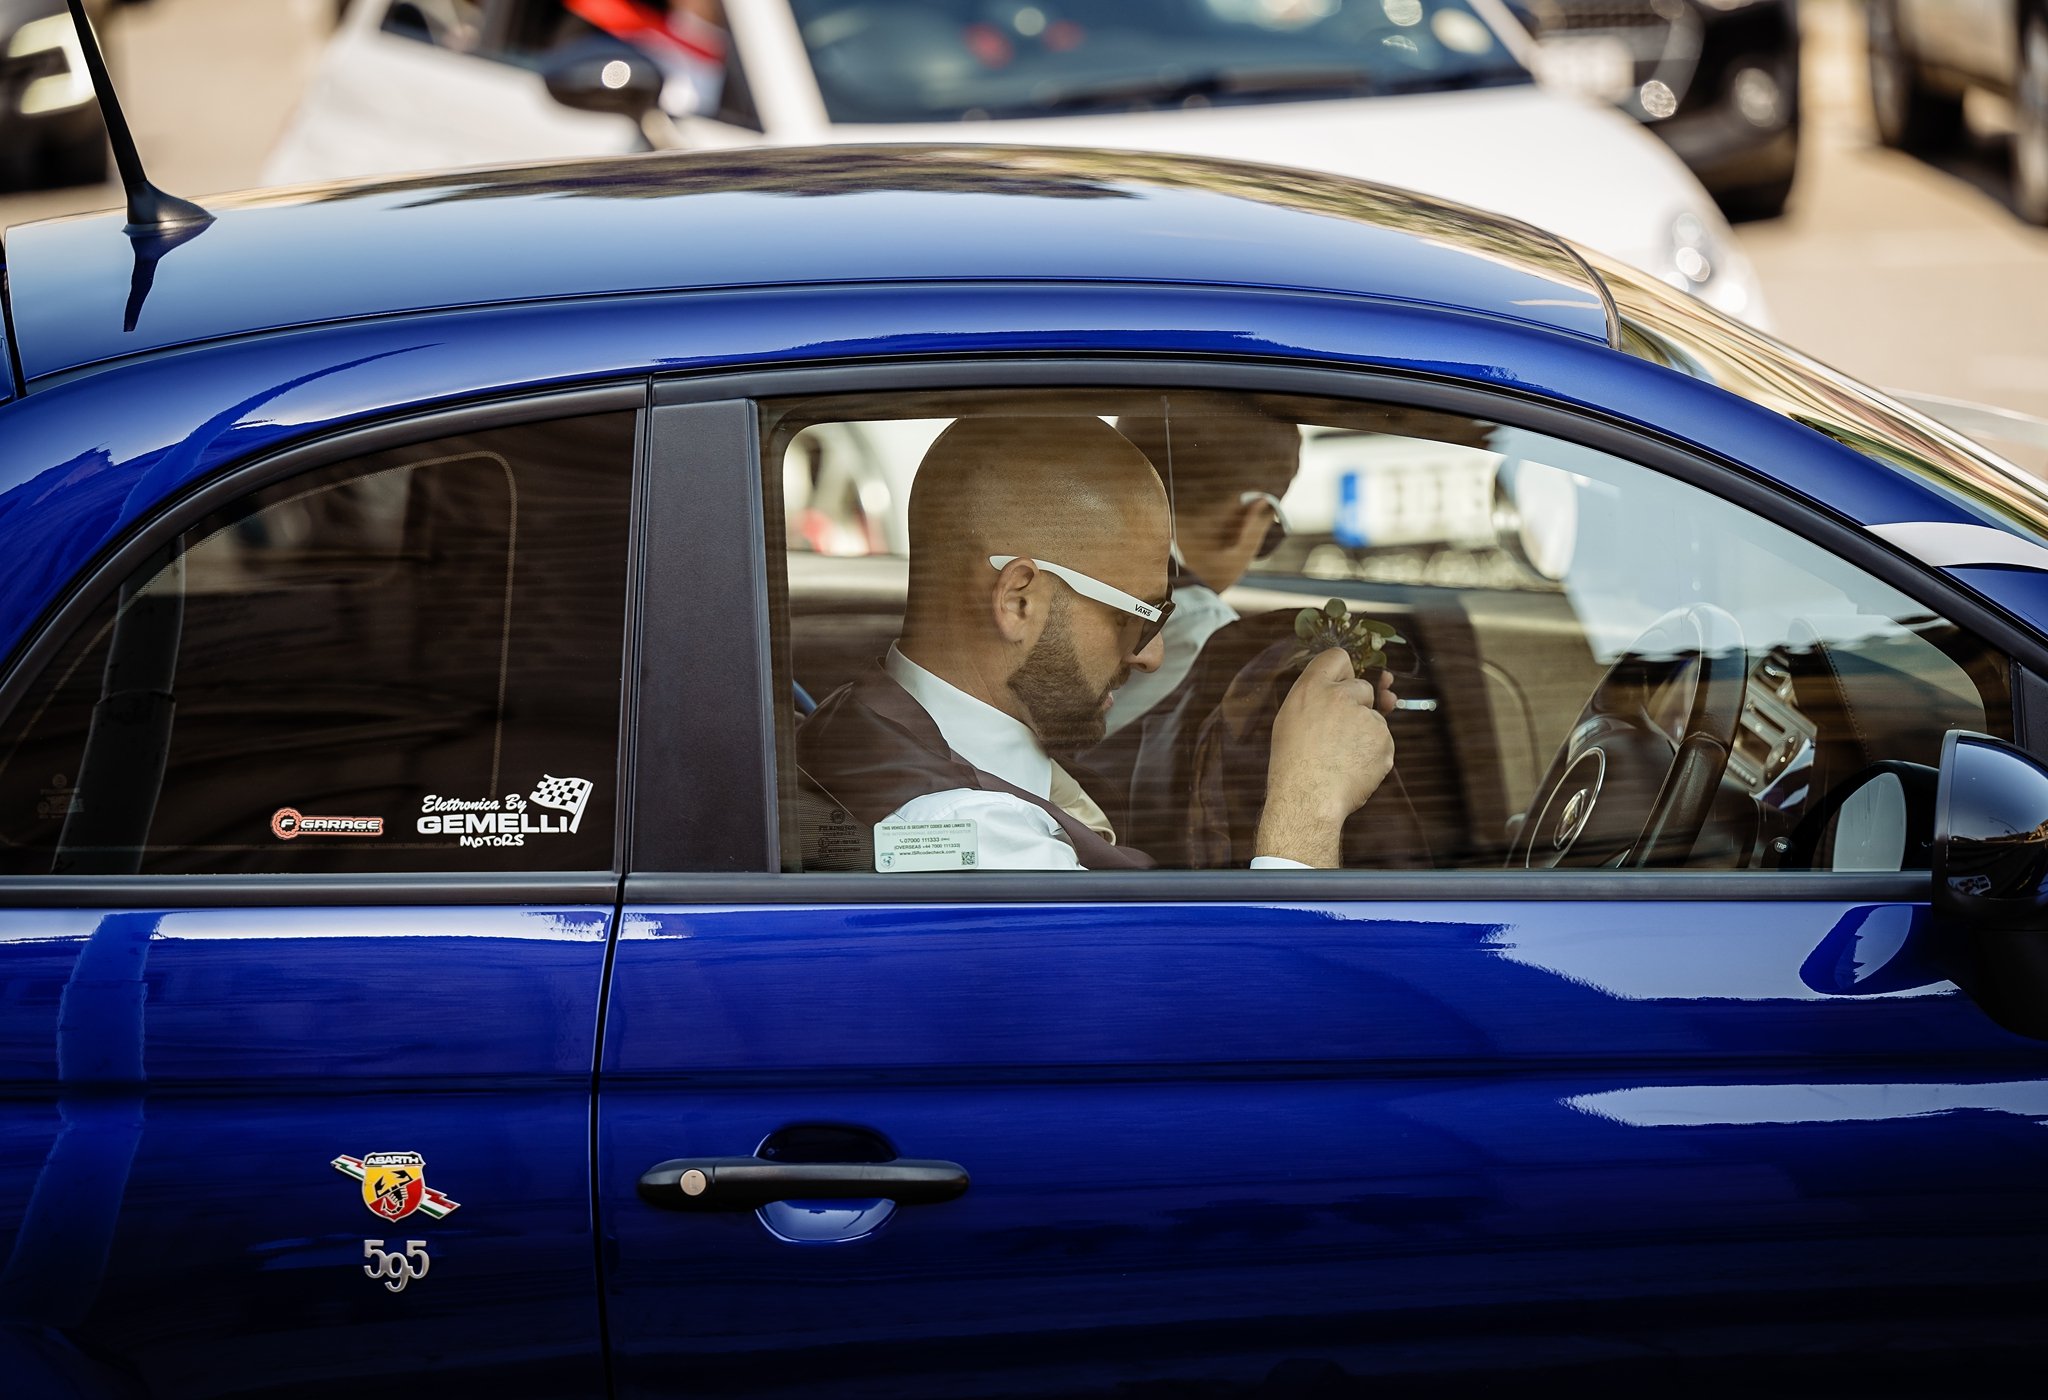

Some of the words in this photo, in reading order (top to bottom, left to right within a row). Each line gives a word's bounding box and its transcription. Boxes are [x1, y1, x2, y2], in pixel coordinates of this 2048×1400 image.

[1135, 604, 1152, 616] VANS
[421, 794, 500, 813] Elettronica
[505, 794, 528, 814] By
[280, 819, 295, 828] F
[300, 819, 380, 829] GARAGE
[417, 813, 568, 834] GEMELLI
[460, 834, 525, 848] MOTORS
[366, 1156, 419, 1165] ABARTH
[364, 1239, 430, 1293] 595
